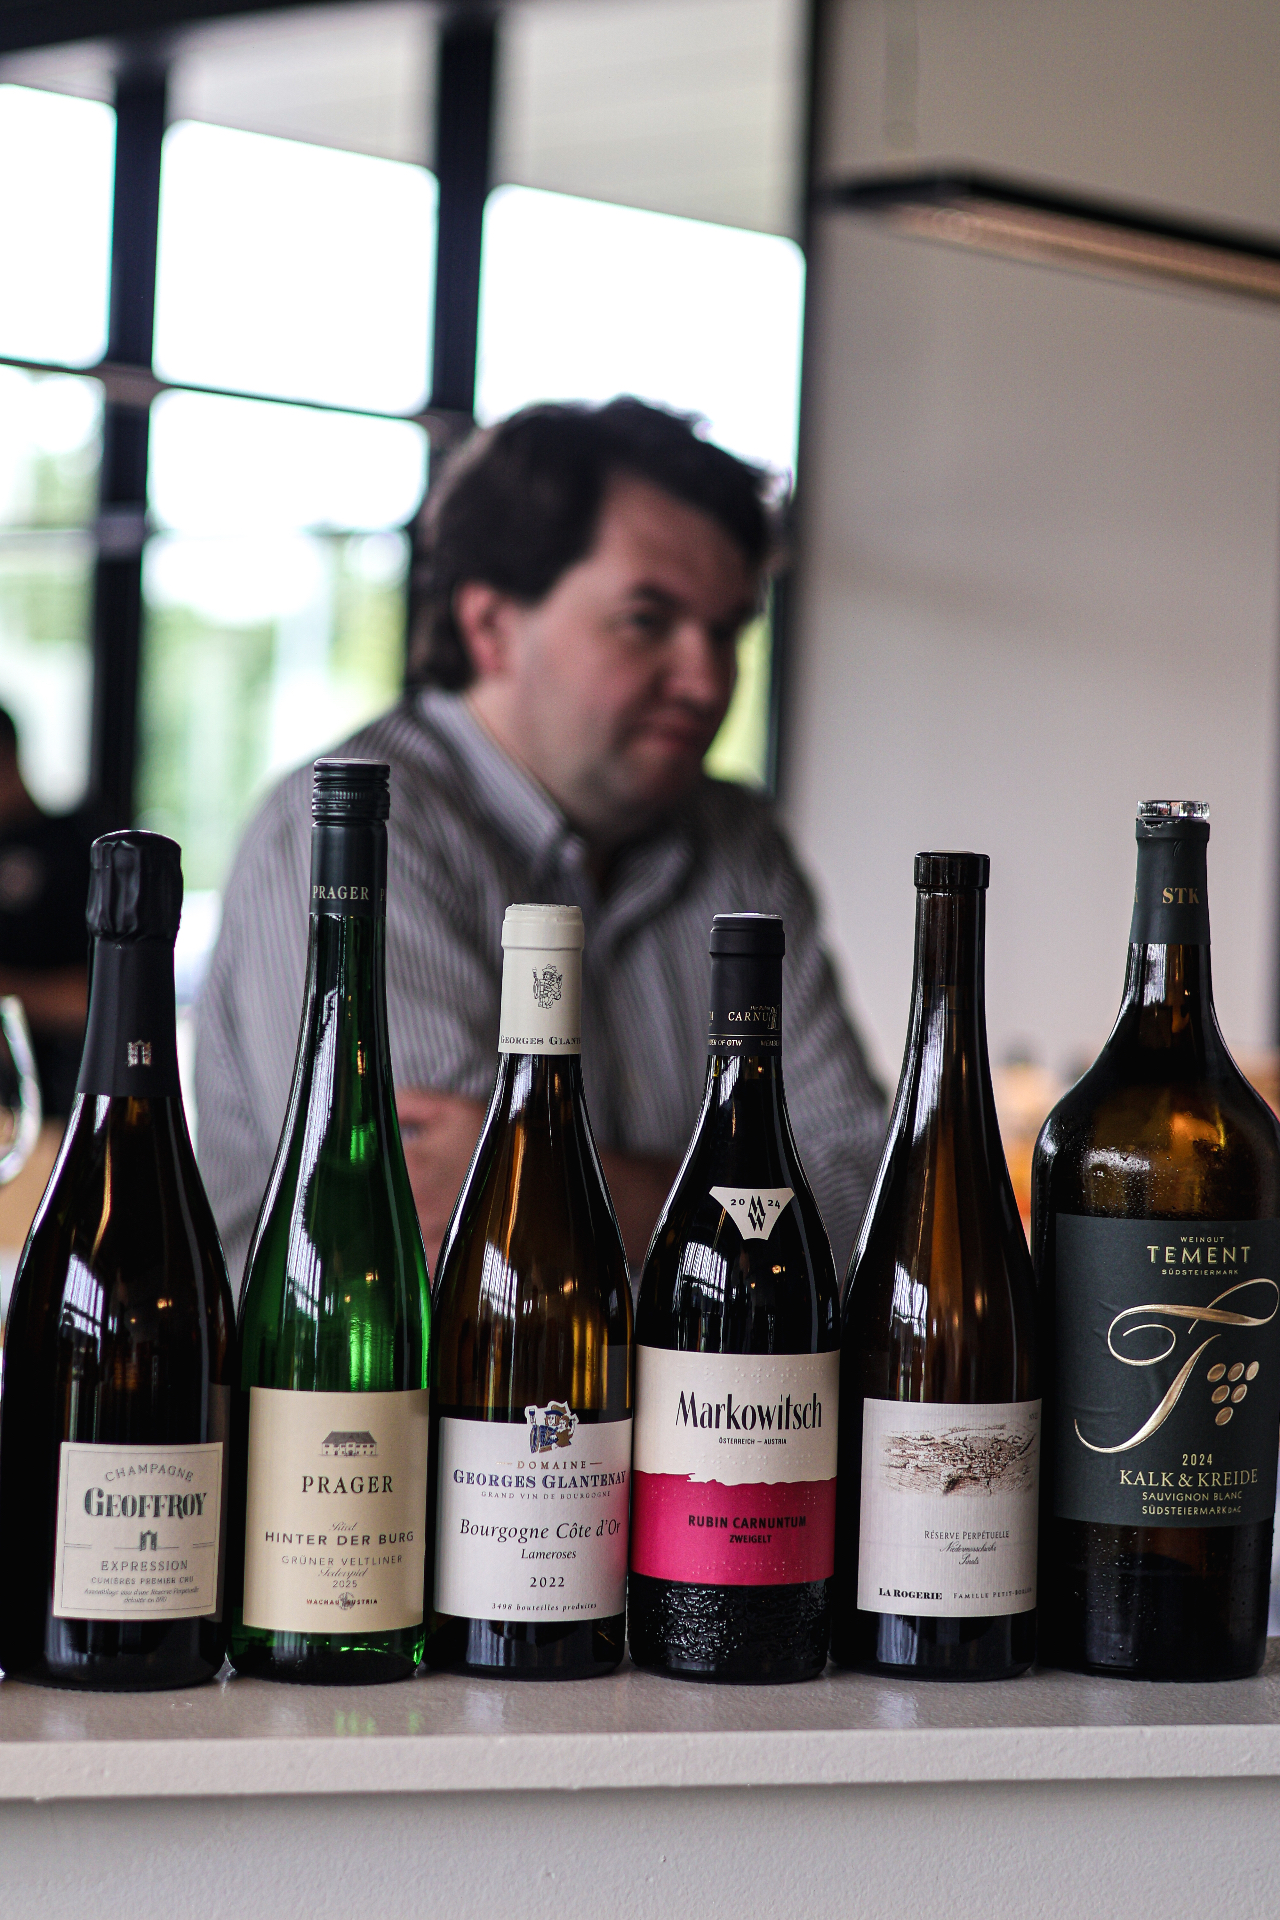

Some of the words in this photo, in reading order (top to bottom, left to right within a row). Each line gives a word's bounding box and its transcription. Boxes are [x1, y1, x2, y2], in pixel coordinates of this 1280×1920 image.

[312, 885, 370, 900] PRAGER
[1162, 886, 1200, 904] STK
[500, 1035, 544, 1045] GEORGES
[730, 1198, 746, 1206] 20
[767, 1199, 781, 1210] 24
[1146, 1245, 1251, 1264] TEMENT
[1161, 1268, 1239, 1276] SÜDSTEIERMARK
[675, 1390, 822, 1431] Markowitsch
[718, 1436, 755, 1445] ÖSTERREICH
[763, 1437, 787, 1445] AUSTRIA
[517, 1460, 587, 1470] DOMAINE
[1182, 1453, 1213, 1466] 2024
[104, 1463, 194, 1482] CHAMPAGNE
[1119, 1469, 1175, 1487] KALK
[1178, 1472, 1194, 1488] &
[1197, 1468, 1258, 1488] KREIDE
[301, 1475, 394, 1494] PRAGER
[453, 1469, 536, 1489] GEORGES
[541, 1470, 626, 1489] GLANTENAY
[481, 1490, 515, 1499] GRAND
[560, 1490, 611, 1500] BOURGOGNE
[1142, 1491, 1209, 1502] SAUVIGNON
[1213, 1490, 1243, 1501] BLANC
[84, 1486, 208, 1519] GEOFFROY
[1141, 1504, 1227, 1515] SÜDSTEIERMARK
[688, 1514, 728, 1528] RUBIN
[732, 1515, 807, 1529] CARNUNTUM
[459, 1518, 549, 1544] Bourgogne
[556, 1523, 591, 1539] Côte
[924, 1530, 960, 1540] RÉSERVE
[962, 1530, 1010, 1540] PERPÉTUELLE
[265, 1531, 327, 1546] HINTER
[337, 1534, 371, 1546] DER
[378, 1531, 414, 1545] BURG
[729, 1534, 773, 1544] ZWEIGELT
[281, 1555, 334, 1566] GRÜNER
[341, 1554, 403, 1566] VELTLINER
[521, 1549, 577, 1560] Lameroses
[101, 1560, 188, 1572] EXPRESSION
[140, 1577, 176, 1585] PREMIER
[332, 1579, 358, 1589] 2025
[529, 1576, 565, 1588] 2022
[878, 1587, 891, 1597] LA
[893, 1589, 943, 1600] ROGERIE
[516, 1603, 559, 1611] bouteilles
[562, 1602, 597, 1612] produites
